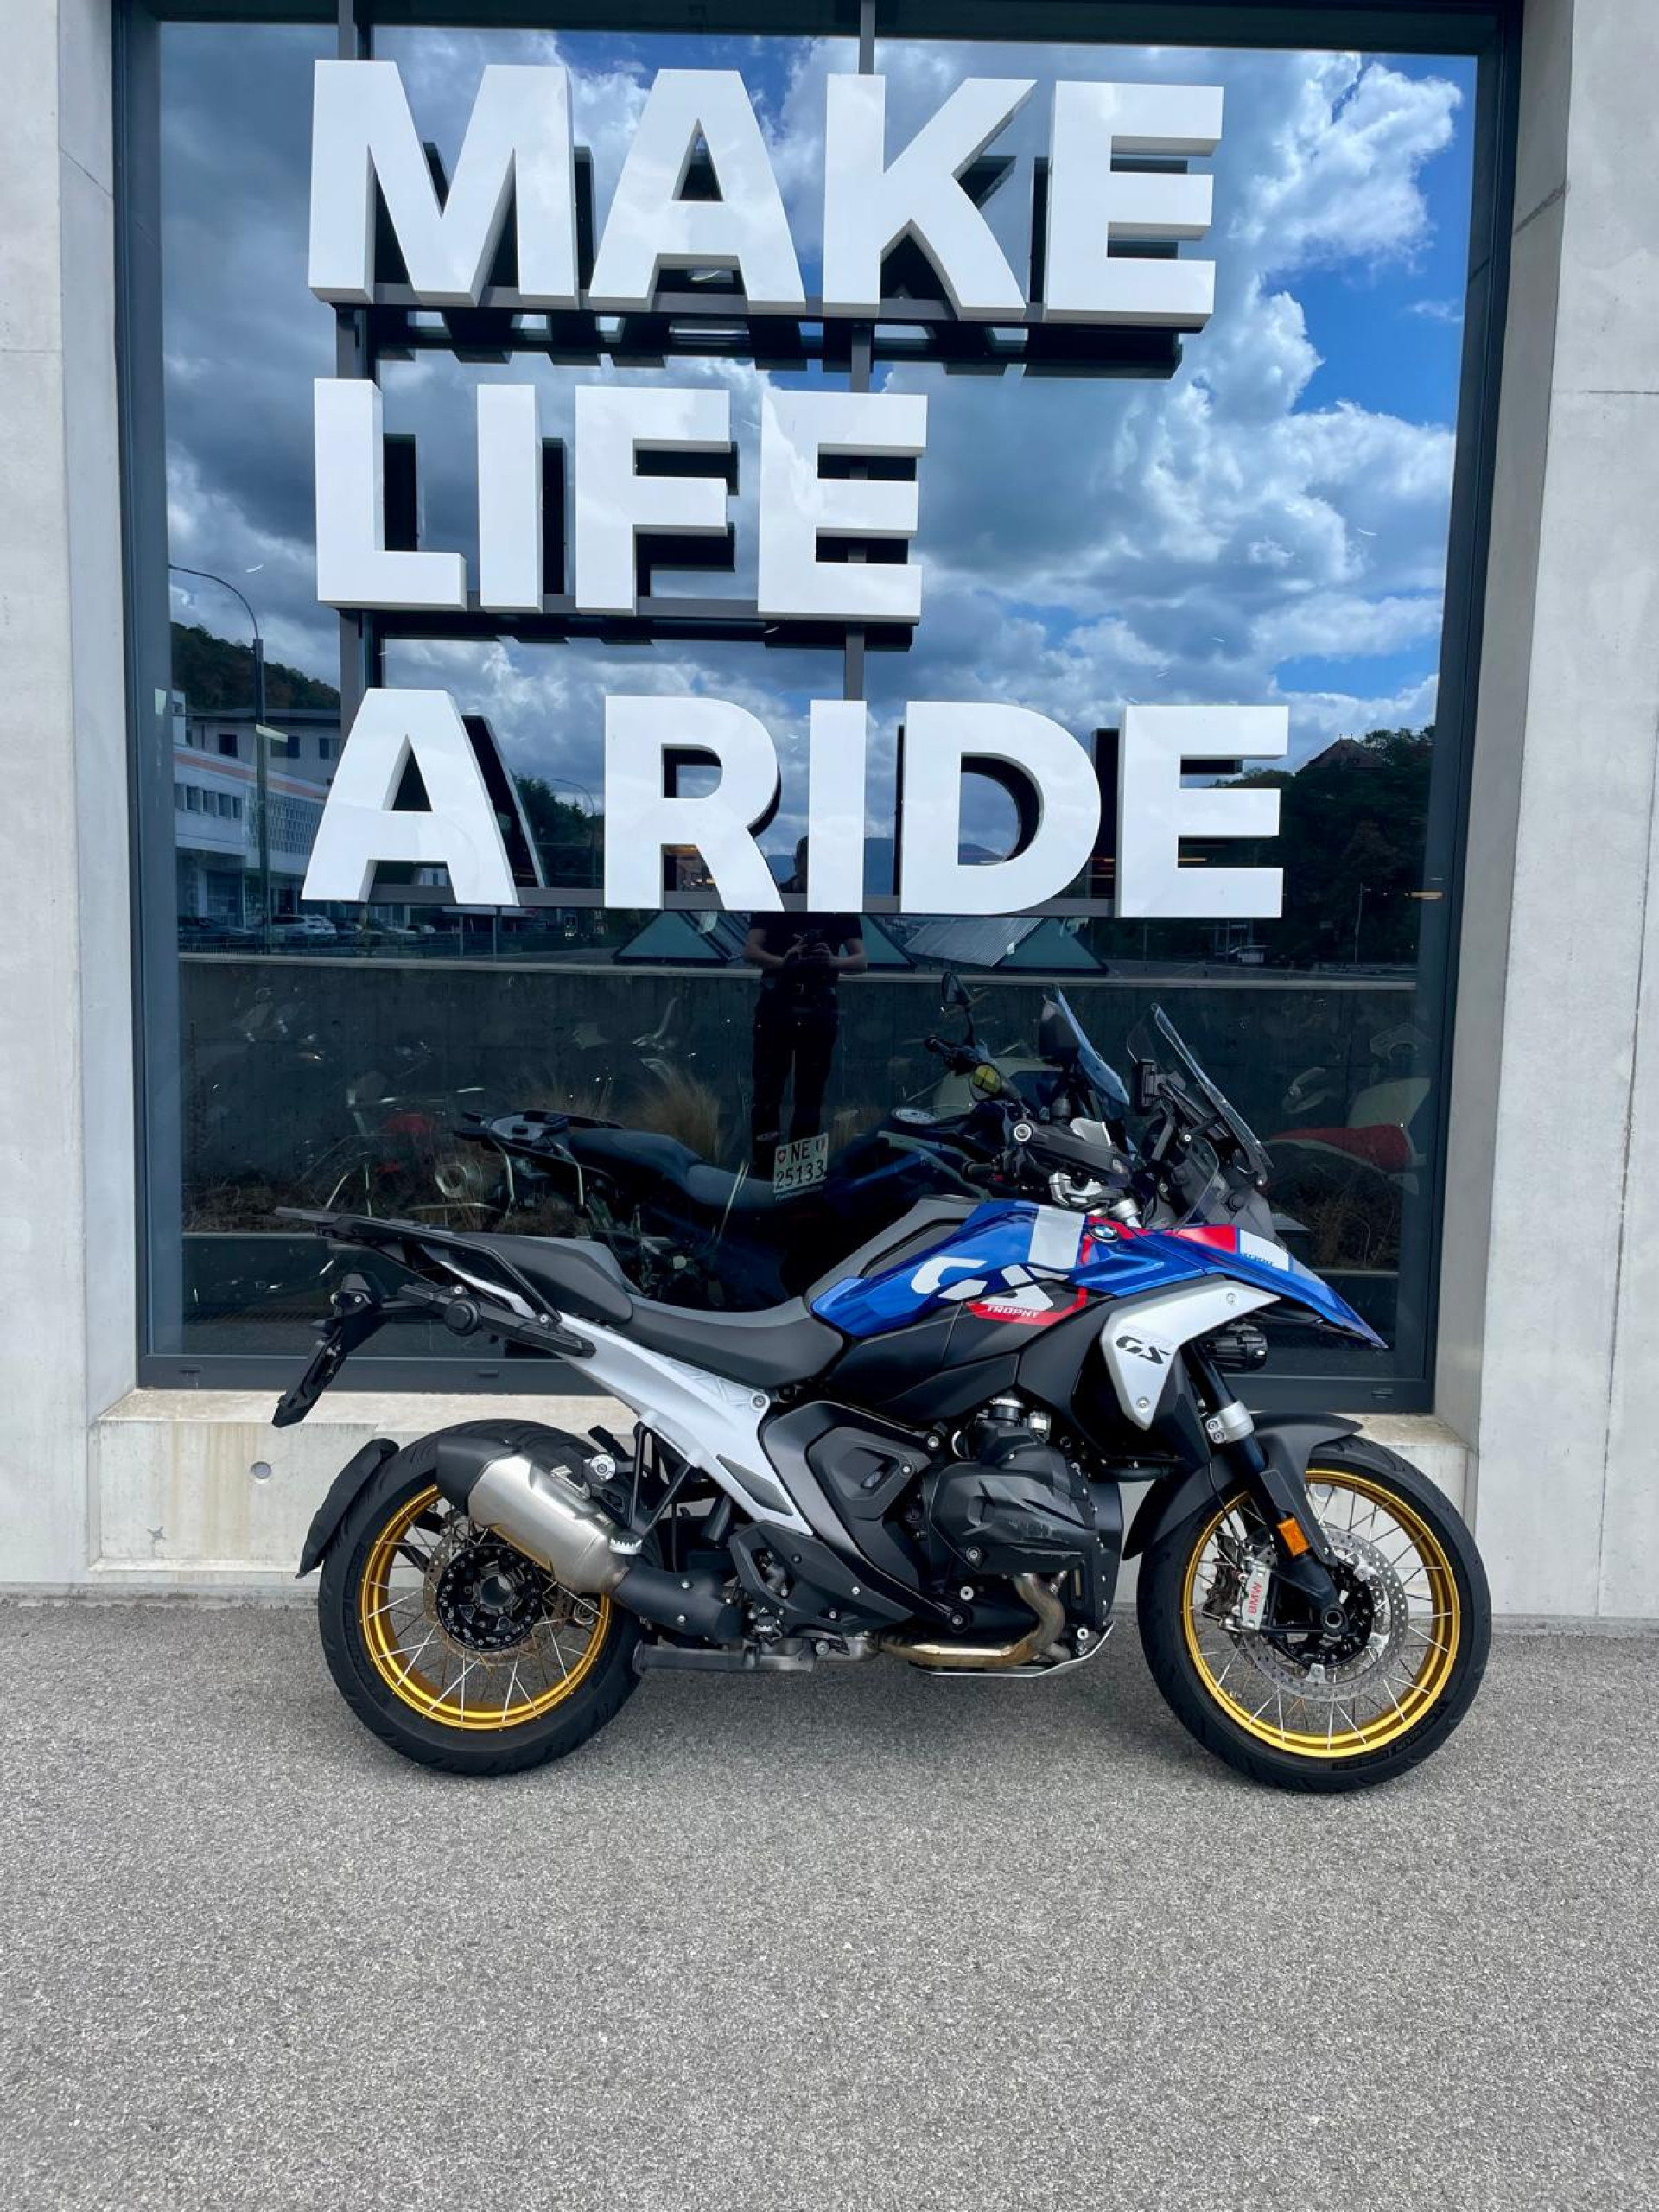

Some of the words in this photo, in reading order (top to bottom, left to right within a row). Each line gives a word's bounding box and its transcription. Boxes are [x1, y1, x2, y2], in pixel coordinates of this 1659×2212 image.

[308, 59, 1224, 328] MAKE
[314, 378, 929, 622] LIFE
[301, 688, 520, 908] A
[604, 695, 1290, 919] RIDE
[790, 1140, 811, 1164] NE
[775, 1159, 823, 1190] 25133
[987, 1304, 1040, 1319] TROPHY
[1248, 1581, 1262, 1615] BMW
